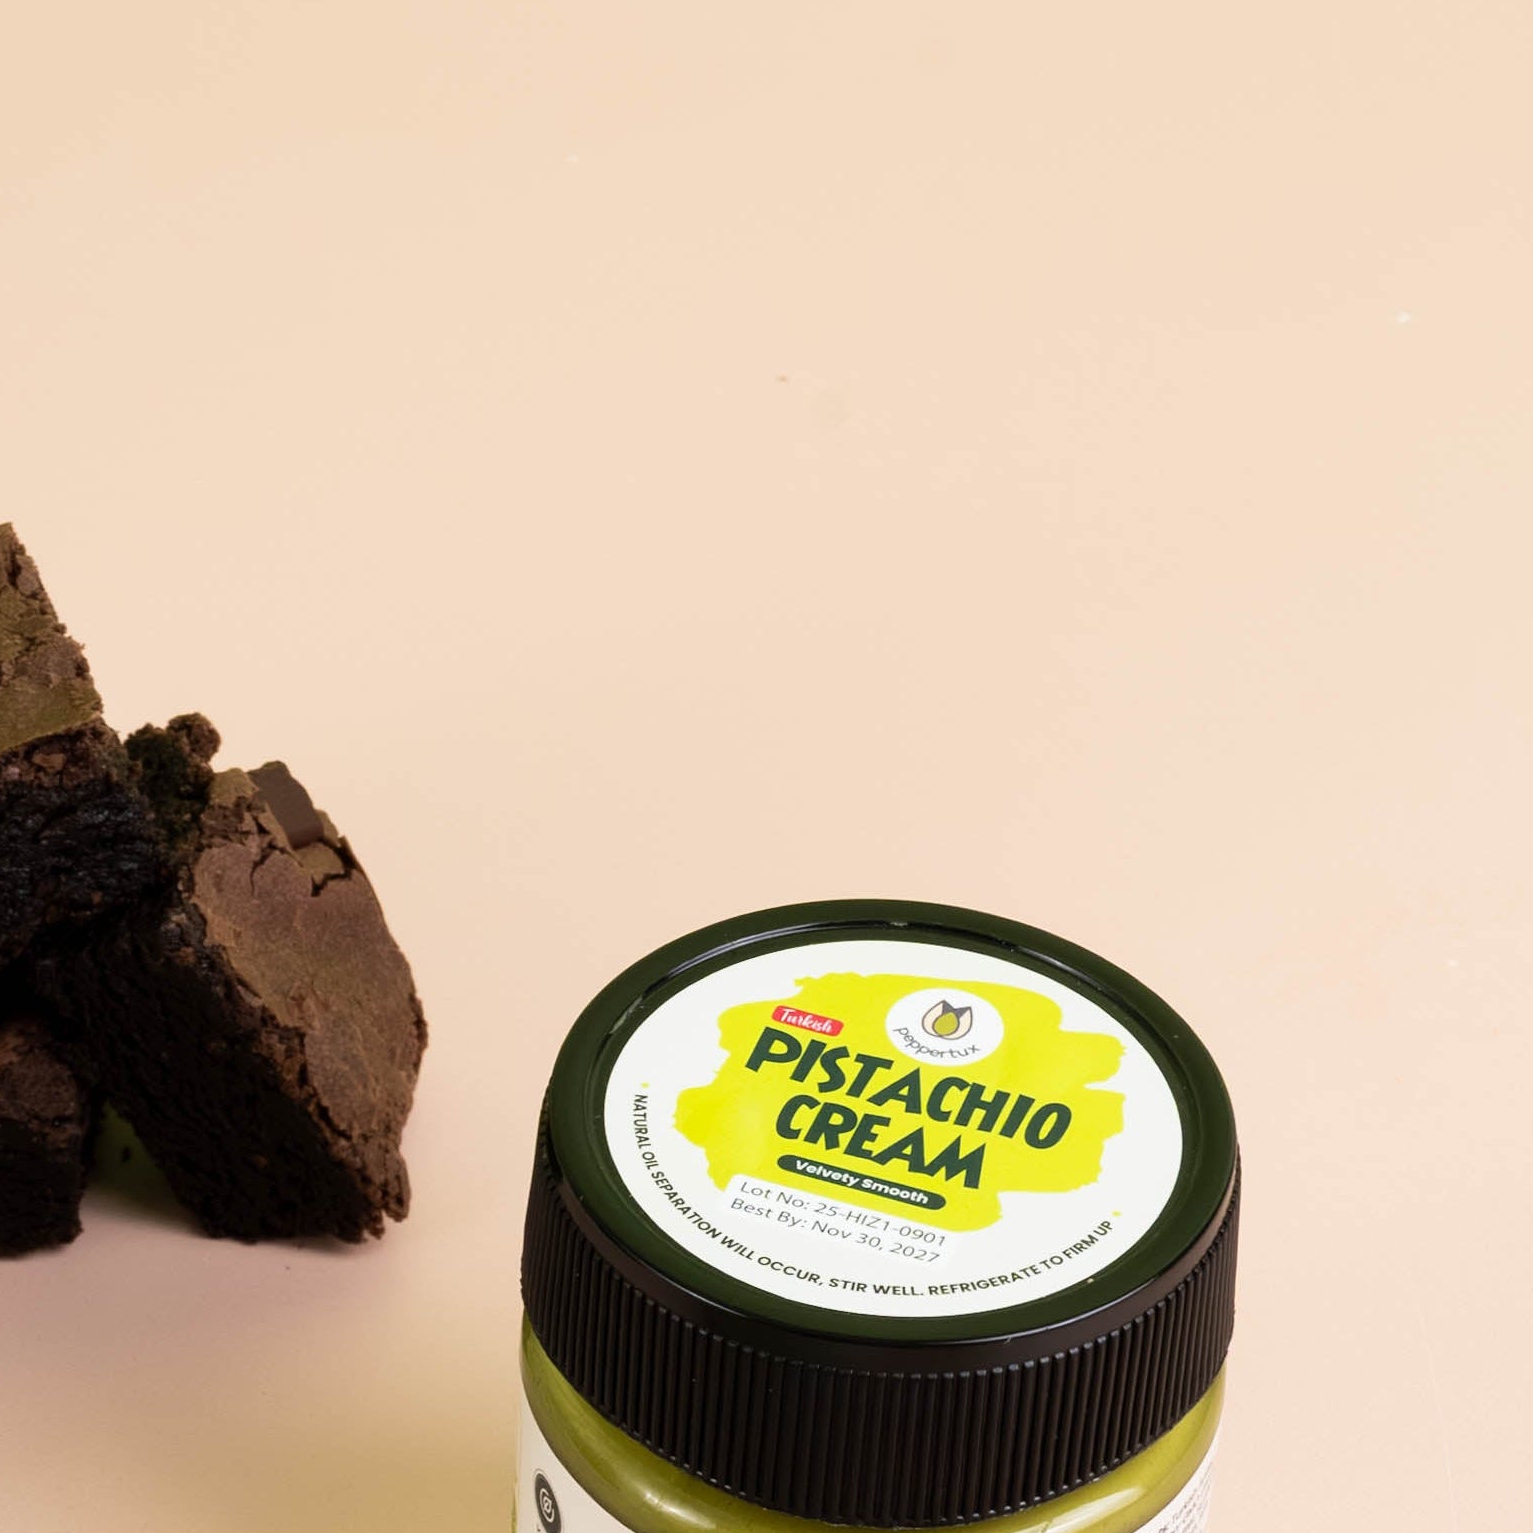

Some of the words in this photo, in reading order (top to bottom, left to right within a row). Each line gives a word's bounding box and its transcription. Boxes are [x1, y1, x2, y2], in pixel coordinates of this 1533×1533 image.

[780, 1008, 834, 1034] Turkish
[893, 1026, 981, 1059] peppertux
[745, 1026, 1072, 1151] PISTACHIO
[632, 1094, 651, 1149] NATURAL
[774, 1093, 988, 1189] CREAM
[641, 1151, 659, 1170] OIL
[740, 1181, 773, 1200] Lot
[775, 1191, 810, 1211] No:
[795, 1159, 861, 1188] Velvety
[861, 1178, 929, 1206] Smooth
[651, 1170, 722, 1239] SEPARATION
[731, 1198, 772, 1219] Best
[777, 1211, 809, 1231] By:
[811, 1219, 854, 1242] Nov
[855, 1232, 883, 1252] 30,
[890, 1241, 941, 1264] 2027
[1093, 1220, 1114, 1239] UP
[721, 1235, 758, 1261] WILL
[1062, 1233, 1099, 1260] FIRM
[757, 1256, 823, 1287] OCCUR,
[1039, 1255, 1064, 1271] TO
[829, 1278, 868, 1293] STIR
[872, 1284, 924, 1297] WELL.
[928, 1264, 1042, 1295] REFRIGERATE
